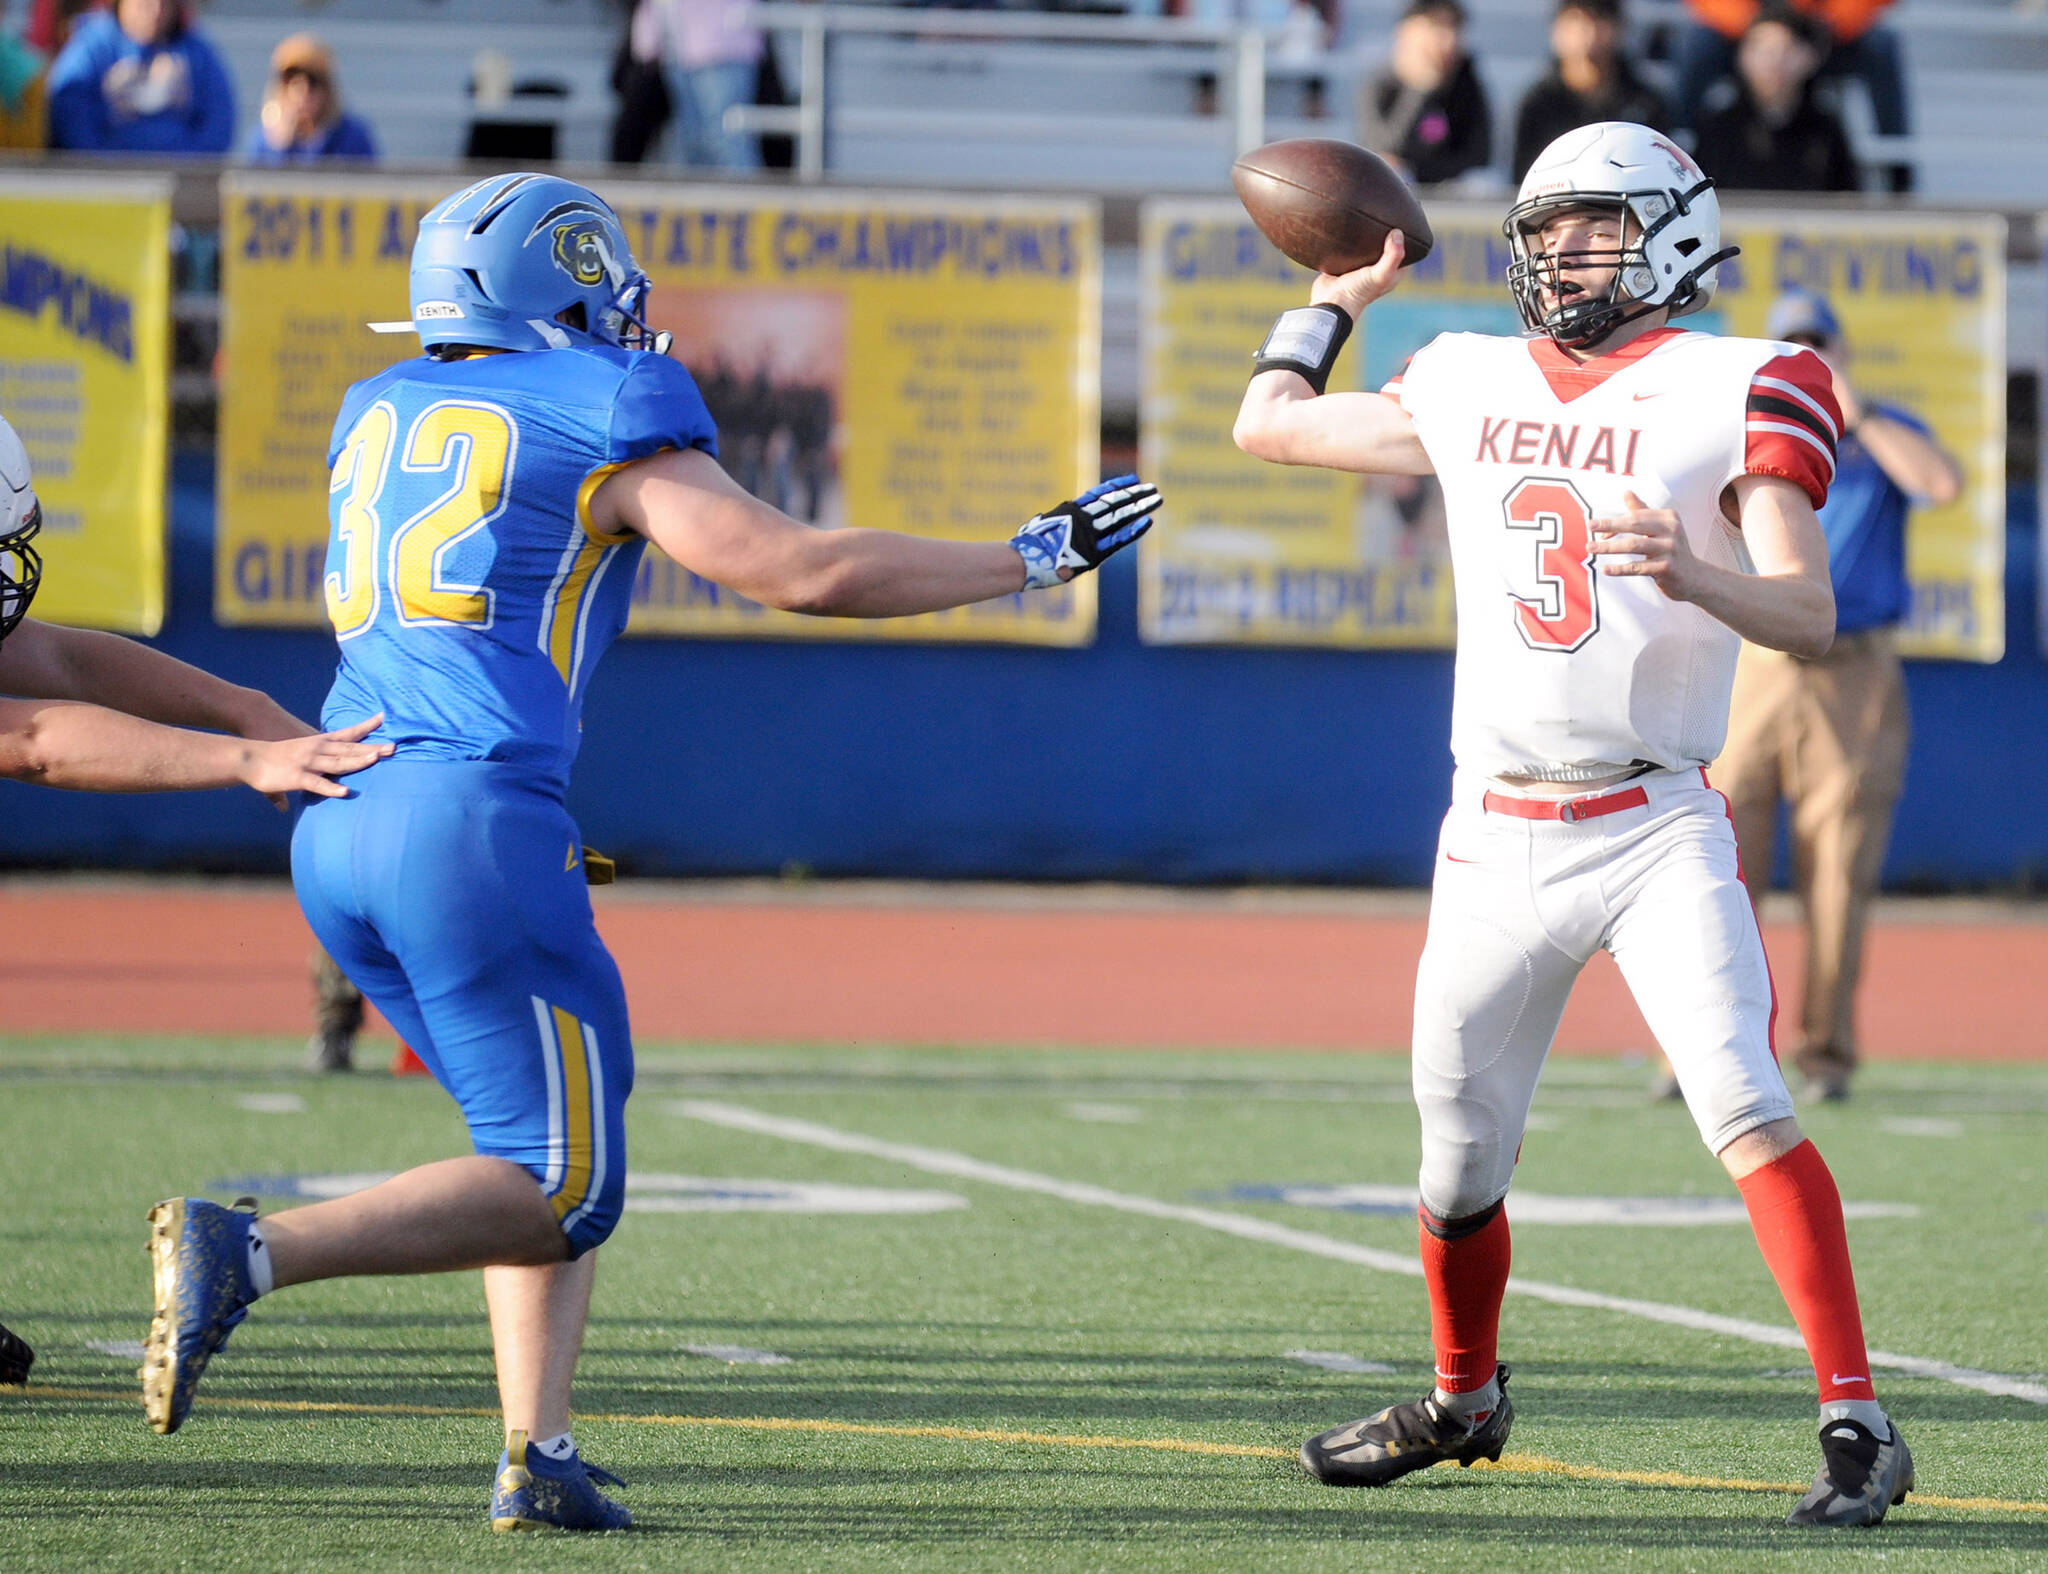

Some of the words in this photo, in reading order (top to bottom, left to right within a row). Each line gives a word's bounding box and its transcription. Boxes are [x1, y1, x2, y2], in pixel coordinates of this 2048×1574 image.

[245, 204, 354, 262] 2011
[634, 208, 752, 273] TATE
[775, 213, 1077, 280] CHAMPIONS
[1164, 222, 1298, 284] GIRL
[1776, 234, 1983, 298] DIVING
[418, 305, 459, 318] XENITH
[1474, 416, 1642, 477] KENAI
[324, 400, 519, 641] 32
[1501, 475, 1600, 654] 3
